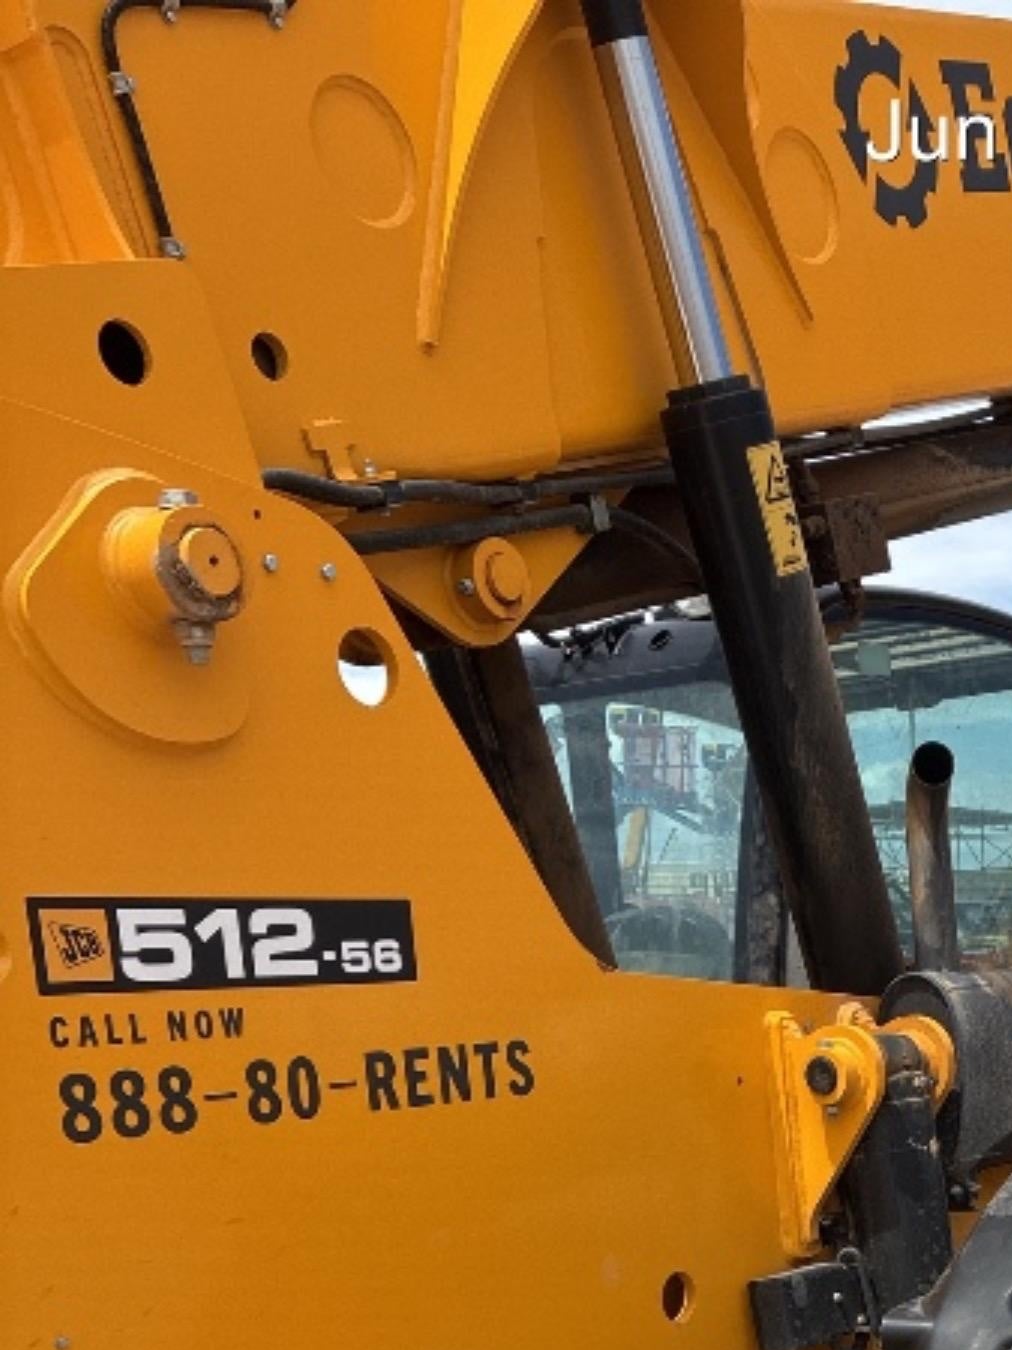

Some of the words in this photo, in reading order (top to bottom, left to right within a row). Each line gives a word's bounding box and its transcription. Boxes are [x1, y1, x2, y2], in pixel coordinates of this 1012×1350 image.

[49, 1013, 147, 1048] CALL
[167, 1007, 245, 1042] NOW
[58, 1040, 536, 1144] 888-80-RENTS
